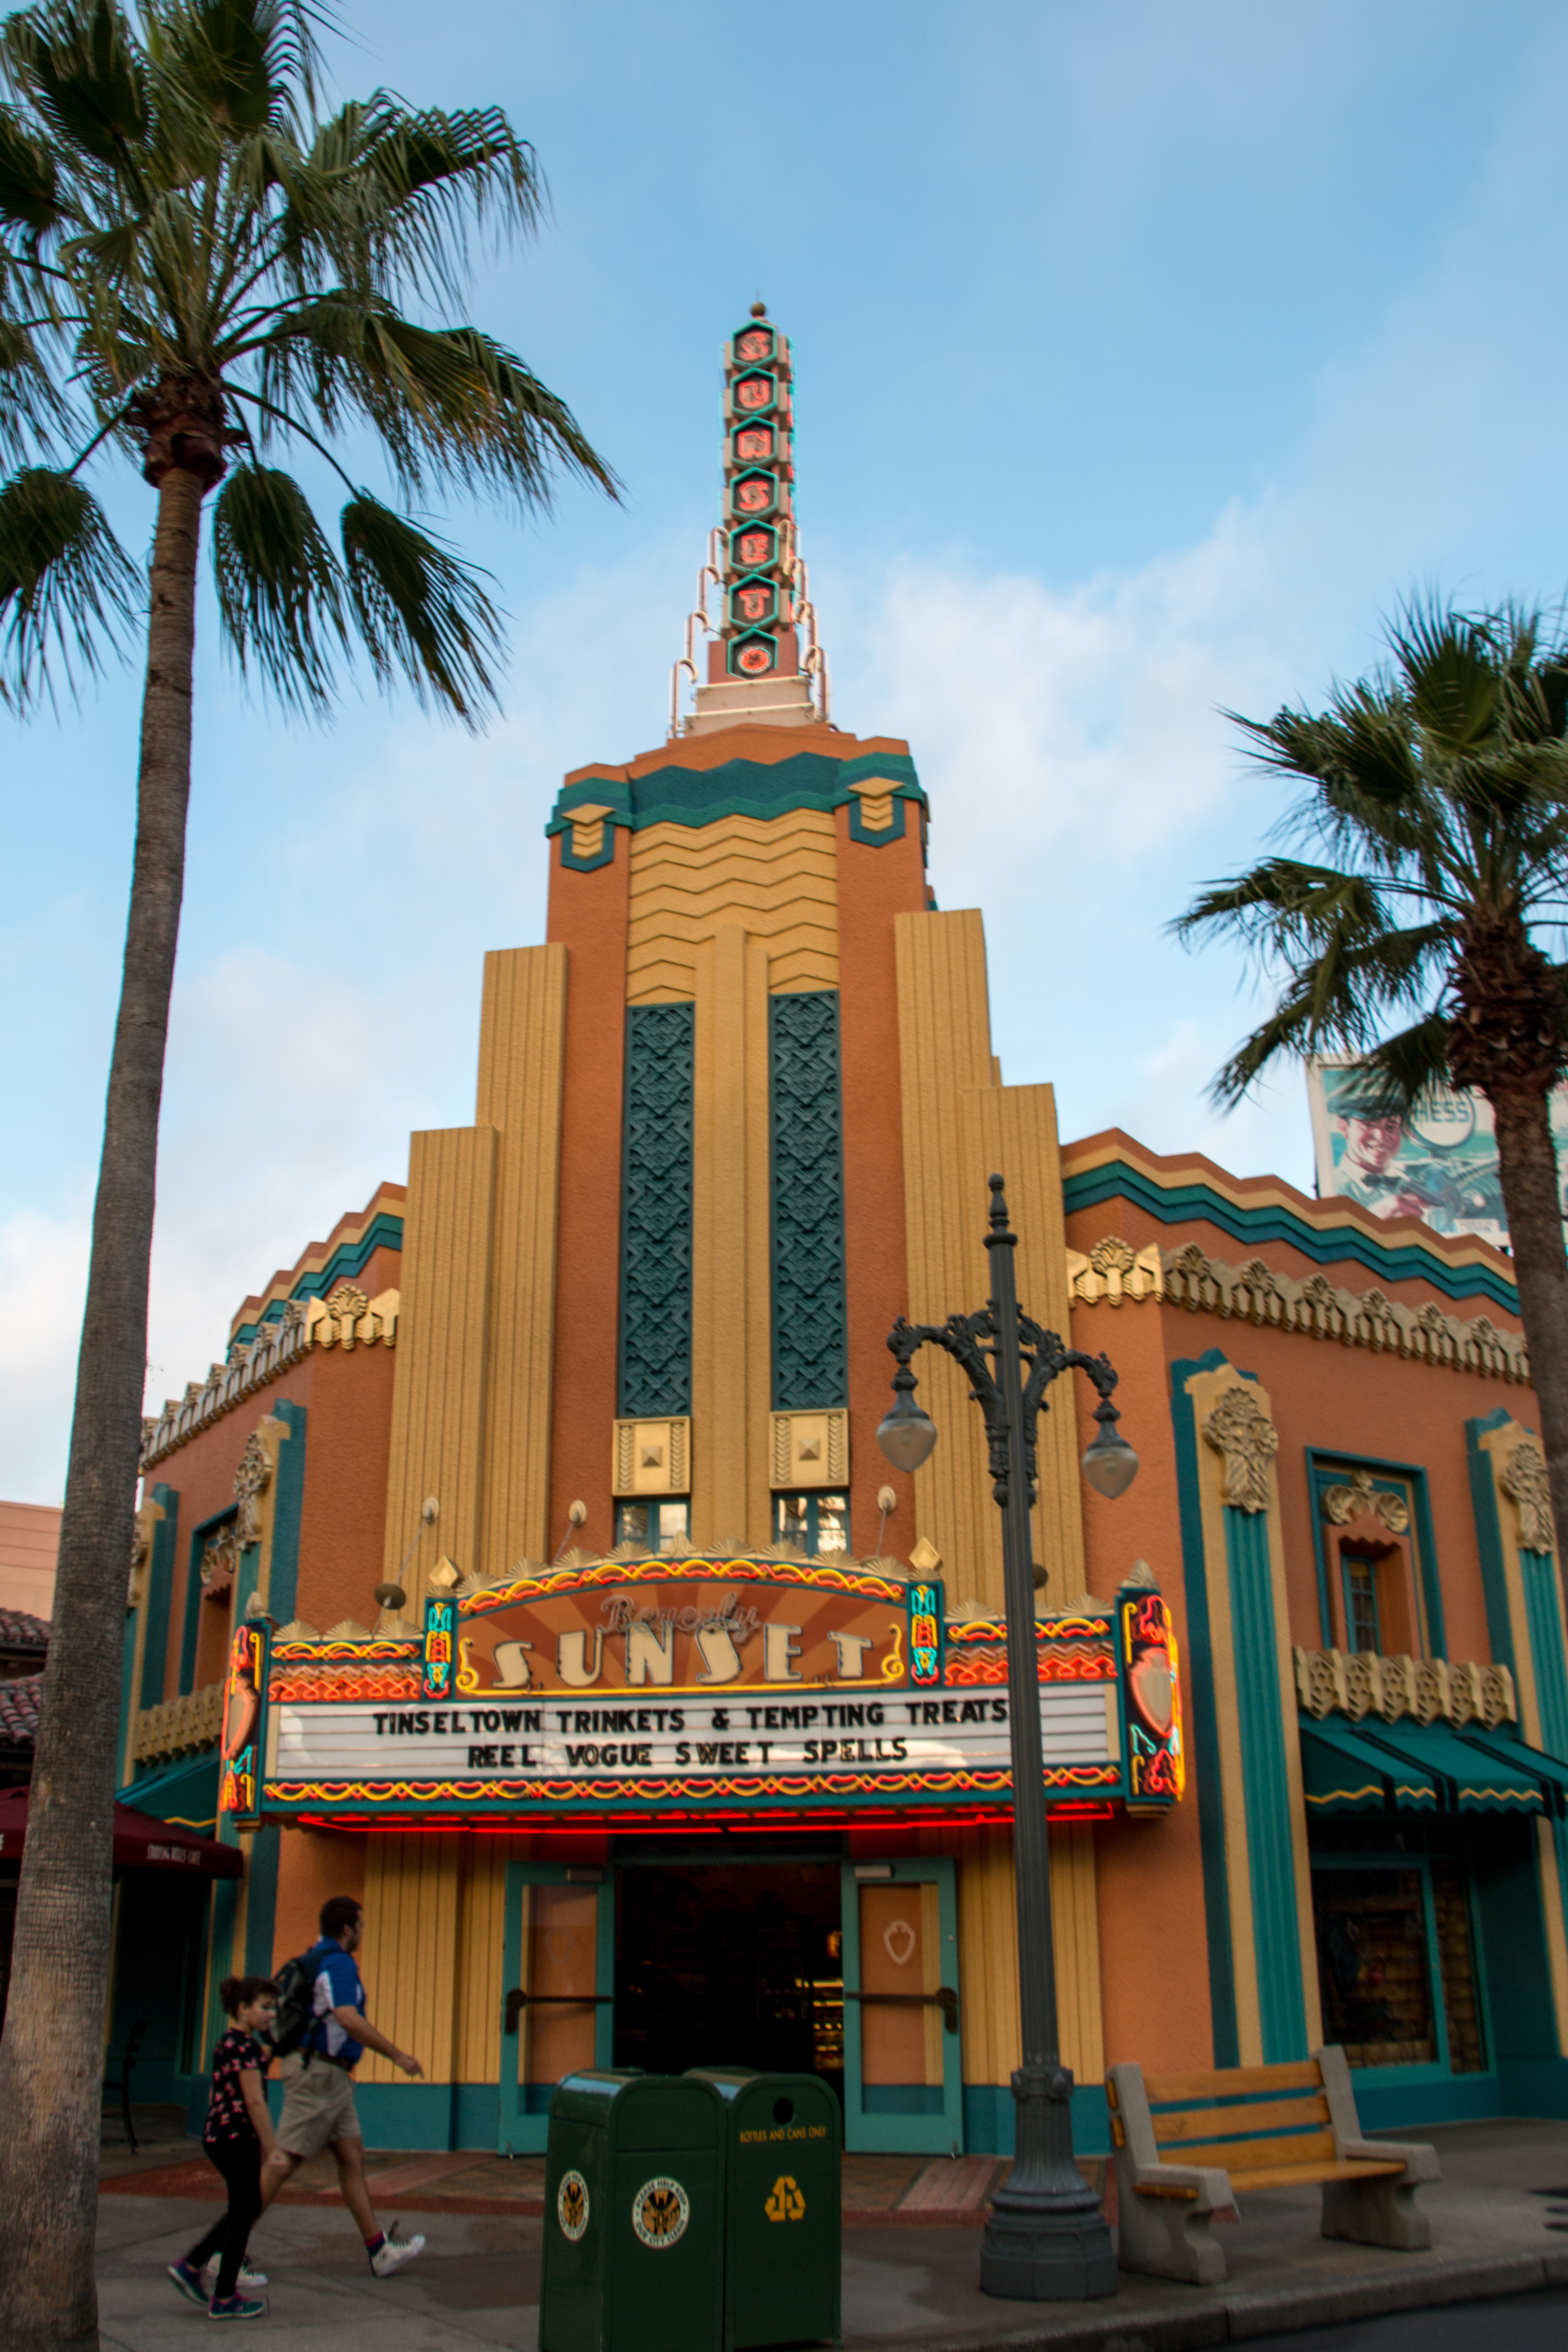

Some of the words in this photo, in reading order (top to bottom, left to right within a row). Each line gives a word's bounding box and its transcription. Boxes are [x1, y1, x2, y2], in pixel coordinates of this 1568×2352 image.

[738, 331, 771, 619] SUNSET
[1415, 1101, 1470, 1122] HESS
[595, 1591, 762, 1643] Beverly
[490, 1619, 872, 1688] SUNSET
[373, 1709, 541, 1735] TINSELTOWN
[556, 1709, 685, 1734] TRINKETS
[711, 1707, 730, 1731] &
[746, 1702, 884, 1730] TEMPTING
[904, 1699, 1009, 1726] TREATS
[467, 1744, 537, 1769] REEL
[564, 1743, 653, 1767] VOGUE
[674, 1741, 774, 1766] SWEET
[803, 1737, 908, 1764] SPELLS
[740, 2130, 767, 2143] BOTTLES
[770, 2128, 785, 2141] AND
[787, 2127, 806, 2140] CANS
[808, 2126, 826, 2139] ONLY
[636, 2180, 655, 2208] PLEASE
[657, 2180, 674, 2188] HELP
[675, 2186, 687, 2207] KEEP
[636, 2221, 647, 2239] OUR
[649, 2237, 664, 2245] CITY
[667, 2219, 685, 2242] CLEAN
